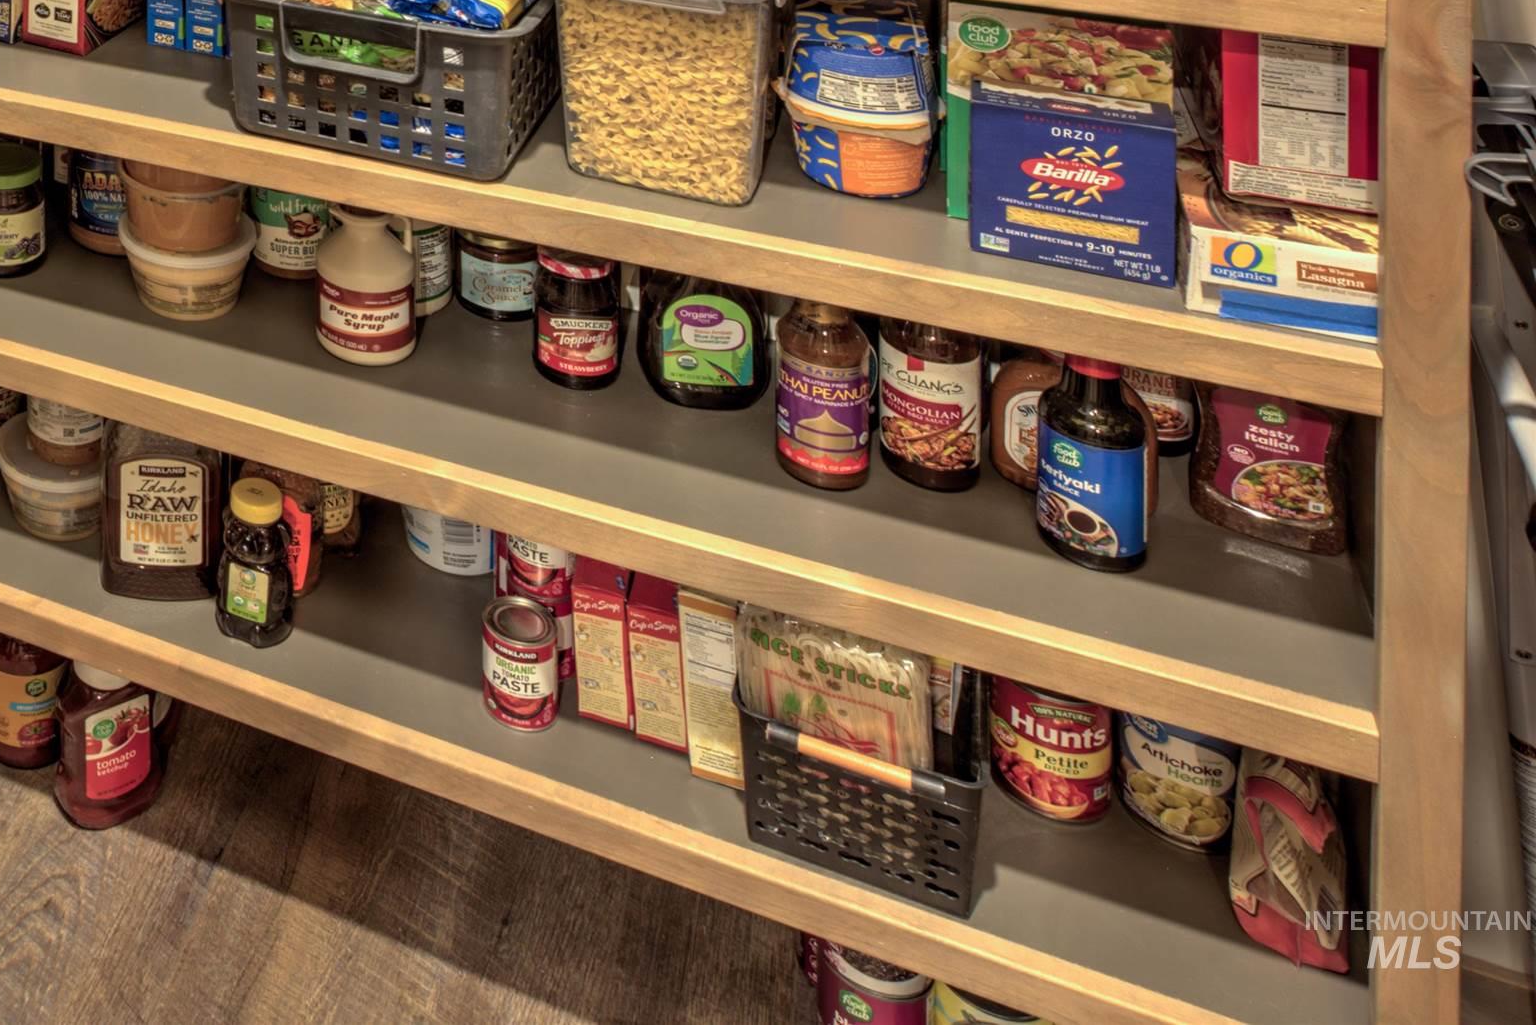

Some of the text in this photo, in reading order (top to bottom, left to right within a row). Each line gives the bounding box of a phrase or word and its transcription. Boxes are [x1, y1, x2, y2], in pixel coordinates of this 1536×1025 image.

[967, 23, 1000, 36] food
[969, 33, 998, 46] club
[1050, 126, 1096, 142] ORZO
[1032, 161, 1113, 187] Barilla
[269, 200, 292, 214] wild
[997, 196, 1149, 226] CAREFULLY SELECTED PREMIUM DURUM WHEAT
[269, 242, 300, 255] SUPER
[1006, 228, 1028, 239] DENTE
[1030, 233, 1073, 247] PERFECTION
[1075, 241, 1083, 249] IN
[1086, 242, 1114, 255] 9-10
[1119, 249, 1152, 260] MINUTES
[1114, 259, 1161, 273] NET LB
[1214, 265, 1274, 284] organics
[1299, 261, 1355, 277] Whole Wheat
[1301, 269, 1365, 290] Lasagna
[481, 290, 520, 305] Sauce
[329, 304, 400, 323] Pure Maple
[679, 308, 719, 321] Organic
[343, 319, 385, 333] Syrup
[559, 360, 608, 374] STRAWBERRY
[779, 369, 809, 394] THAI
[896, 370, 963, 394] CHANG'S
[883, 386, 961, 421] MONGOLIAN
[1245, 432, 1301, 453] Italian
[1249, 424, 1295, 443] zesty
[1053, 442, 1079, 460] food
[141, 466, 185, 475] KIRKLAND
[1057, 455, 1081, 468] club
[137, 478, 187, 494] Idaho
[1042, 458, 1102, 495] teriyaki
[127, 493, 200, 512] RAW
[126, 511, 199, 523] UNFILTERED
[126, 523, 199, 544] HONEY
[508, 538, 549, 563] PASTE
[495, 643, 537, 660] KIRKLAND
[495, 656, 537, 675] ORGANIC
[750, 628, 913, 700] RICE STICKS
[492, 671, 541, 694] PASTE
[501, 668, 530, 683] TOMATO
[1033, 706, 1092, 724] 100% NATURAL
[96, 749, 137, 770] tomato
[1034, 747, 1089, 770] Petite
[1141, 741, 1223, 777] Artichoke
[96, 760, 130, 777] ketchup
[1044, 763, 1080, 776] DICED
[1167, 765, 1223, 789] Hearts
